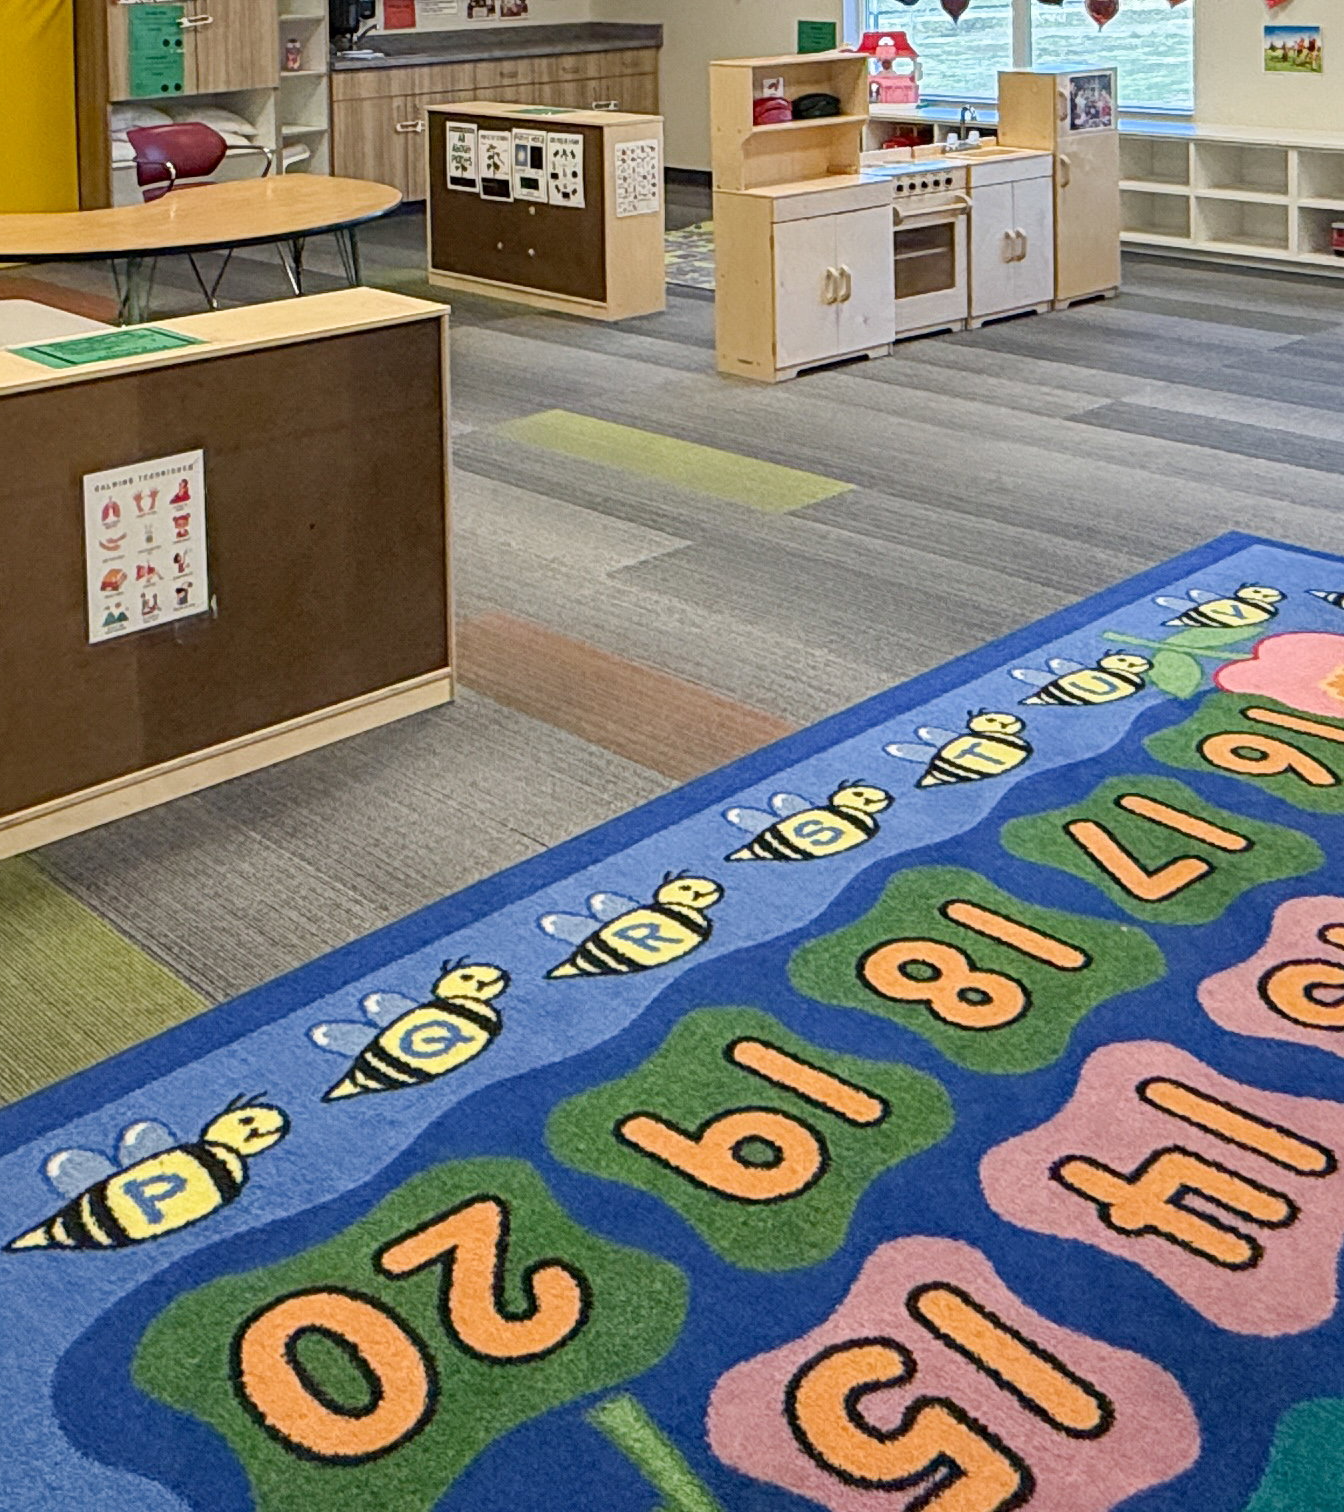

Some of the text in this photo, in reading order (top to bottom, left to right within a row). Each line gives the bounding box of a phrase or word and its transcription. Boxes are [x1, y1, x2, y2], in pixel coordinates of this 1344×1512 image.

[1215, 604, 1248, 620] V
[1070, 676, 1117, 697] U
[954, 739, 1009, 768] T
[792, 819, 846, 848] S
[1062, 792, 1254, 904] 17
[612, 921, 686, 957] R
[859, 897, 1093, 1033] 18
[398, 1020, 476, 1061] Q
[613, 1034, 891, 1204] 19
[122, 1172, 189, 1225] P
[1048, 1075, 1338, 1271] 14
[228, 1192, 594, 1467] 20
[782, 1281, 1115, 1512] 15
